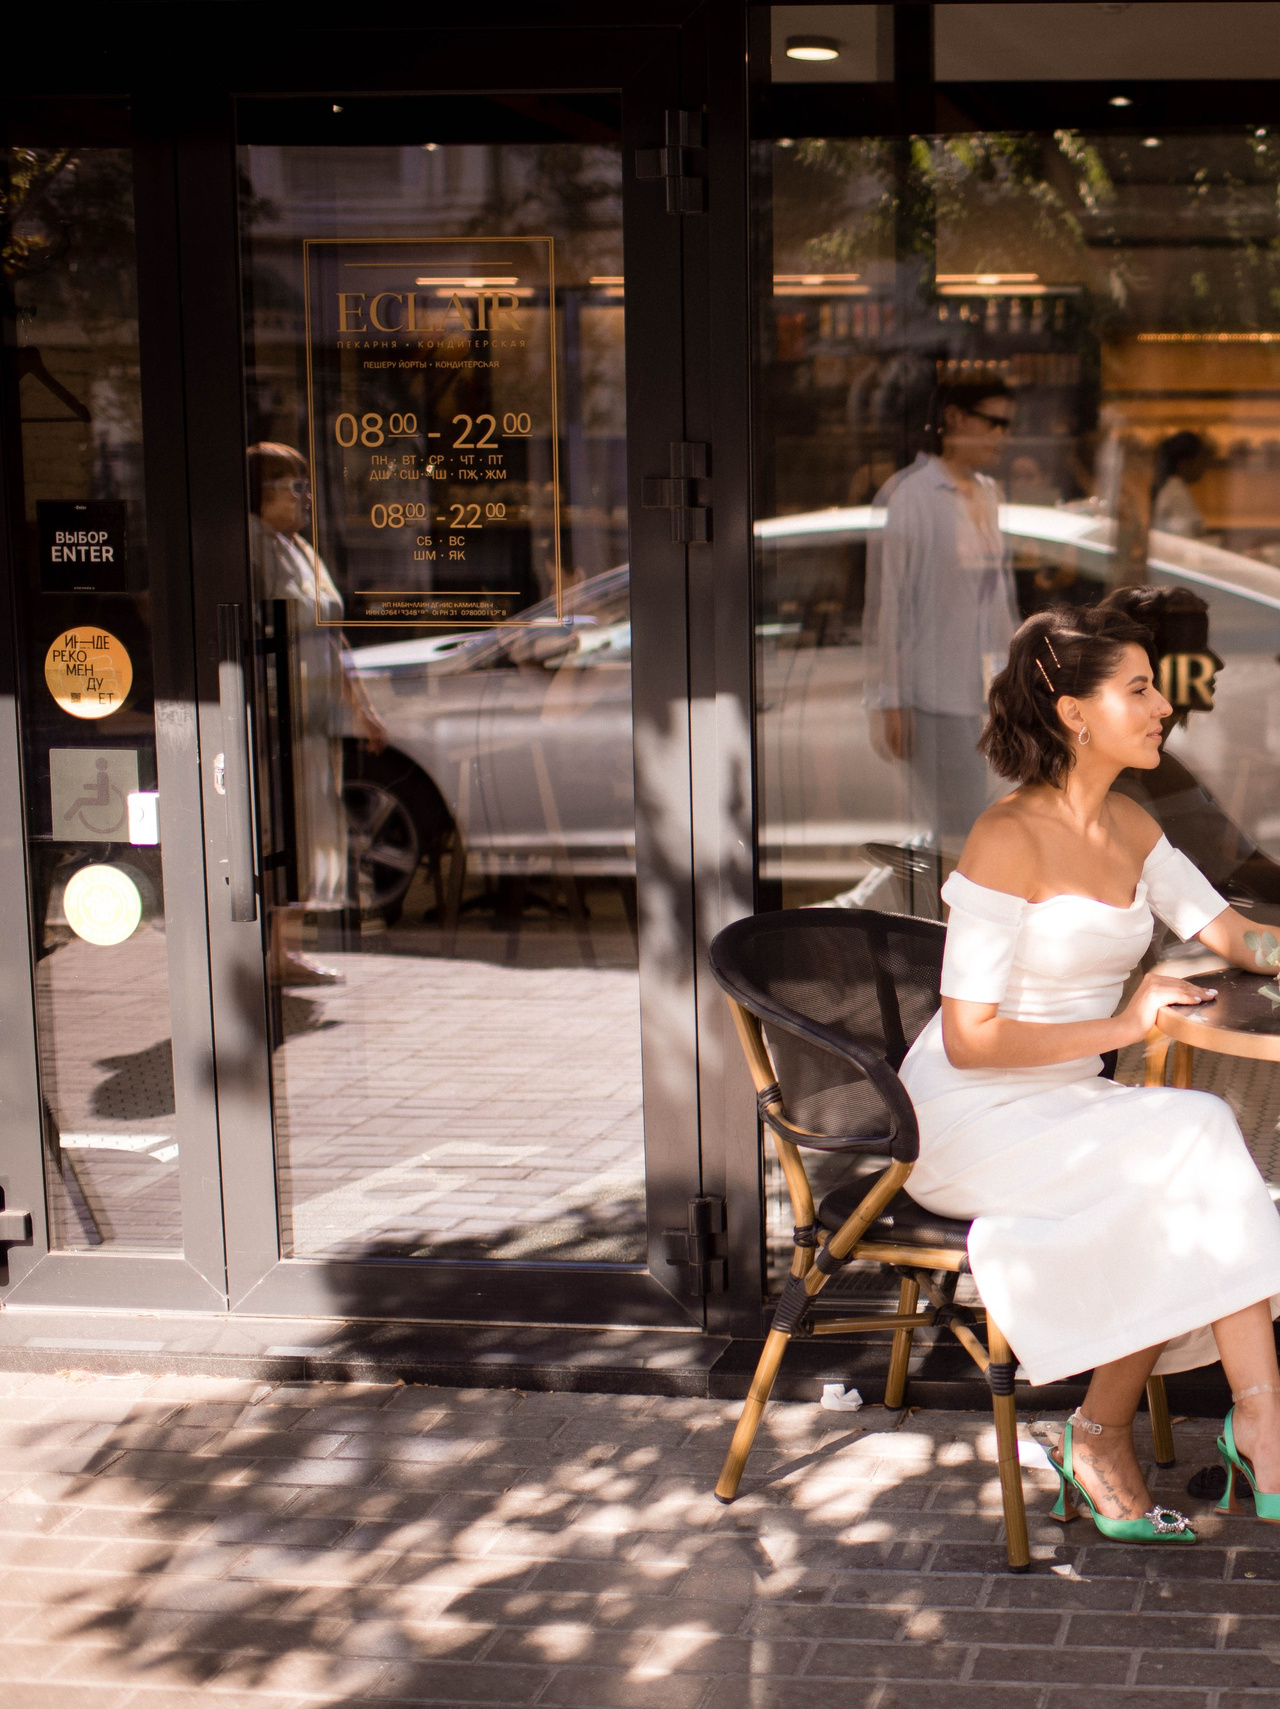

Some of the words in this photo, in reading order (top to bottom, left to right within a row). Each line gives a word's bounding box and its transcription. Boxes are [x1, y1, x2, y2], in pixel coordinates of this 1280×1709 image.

[336, 291, 524, 333] ECLAIR
[336, 341, 398, 349] ПЕКАРНЯ
[417, 340, 526, 349] КОНДИТЕРСКАЯ
[371, 455, 388, 466] ПН
[402, 455, 417, 465] ВТ
[428, 454, 445, 465] СР
[460, 454, 476, 465] ЧТ
[488, 454, 504, 465] ПТ
[399, 469, 420, 480] СШ
[55, 531, 108, 544] ВЫБОР
[416, 536, 433, 546] СБ
[449, 536, 466, 546] ВС
[51, 546, 114, 563] ENTER
[413, 551, 437, 561] ШМ
[448, 551, 466, 561] ЯК
[53, 650, 87, 663] РЕКО
[66, 664, 94, 677] МЕН
[87, 678, 104, 692] ДУ
[98, 692, 115, 705] ЕТ
